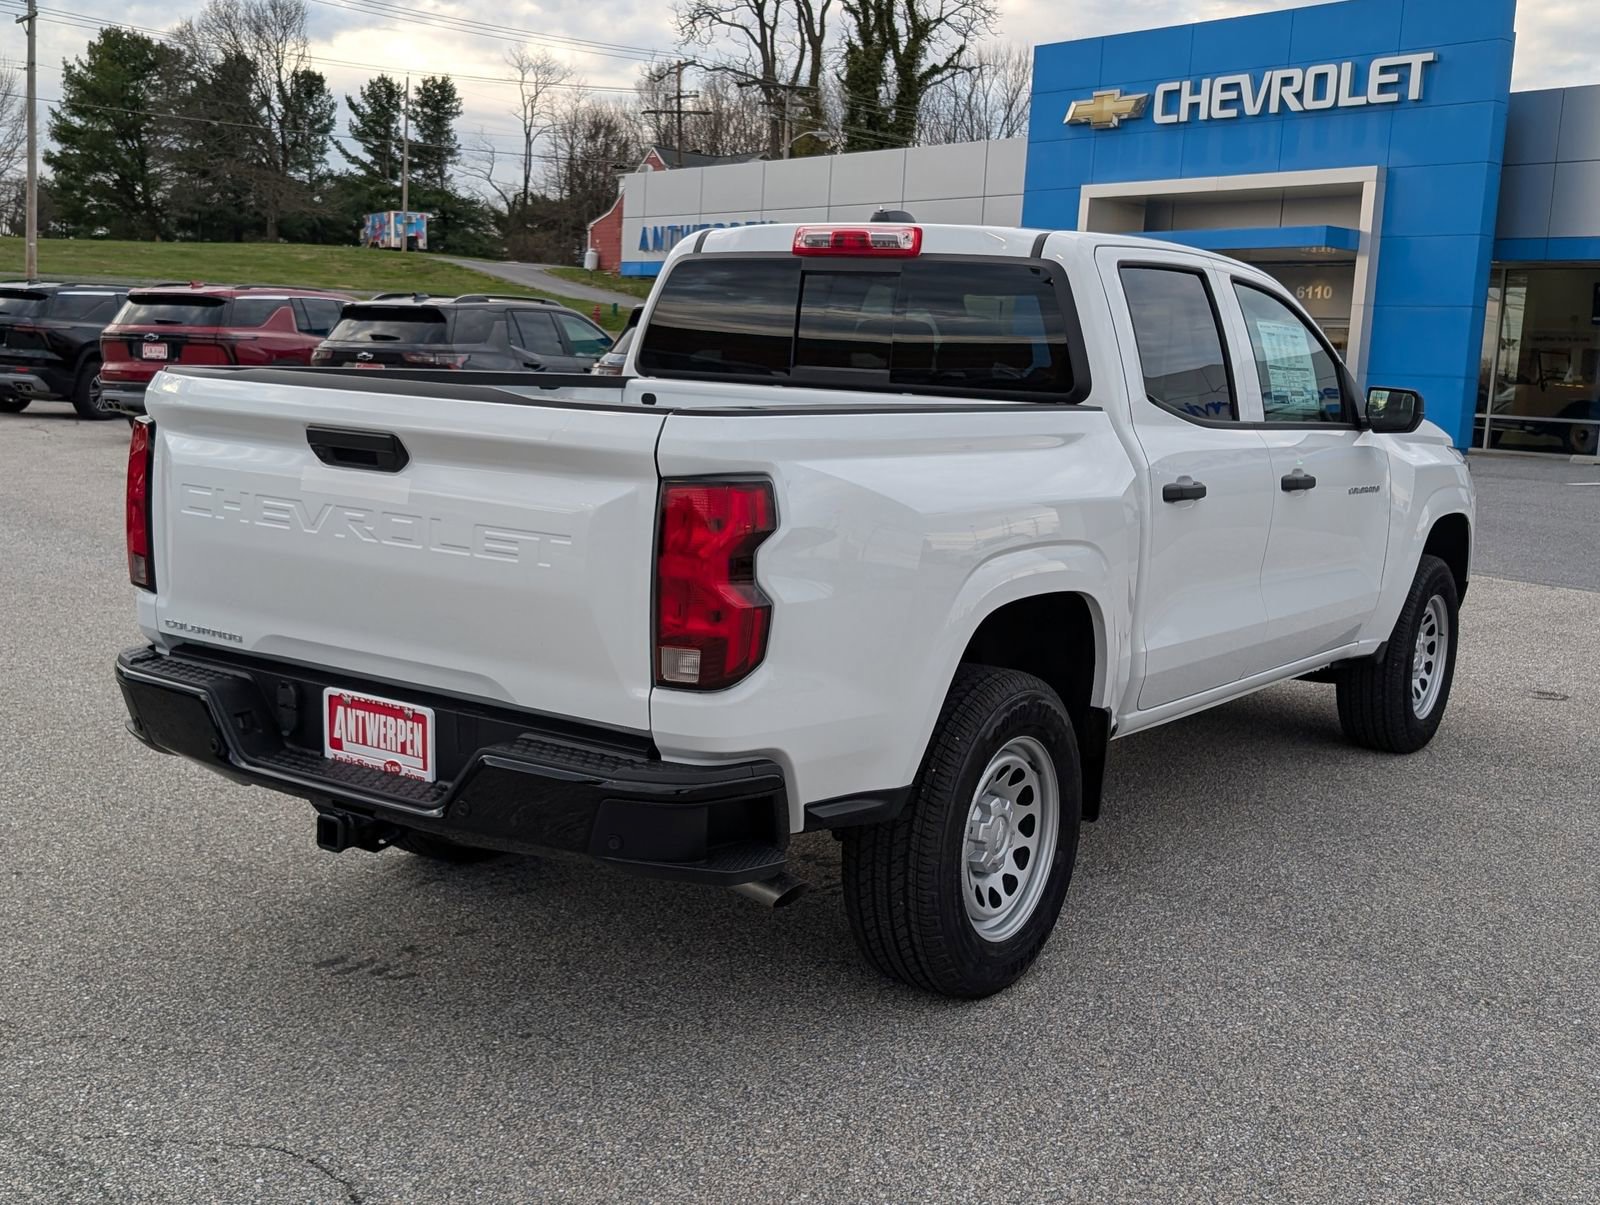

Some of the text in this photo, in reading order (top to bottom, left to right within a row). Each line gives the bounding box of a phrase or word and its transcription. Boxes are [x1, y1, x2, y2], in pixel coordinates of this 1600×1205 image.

[1153, 51, 1436, 124] CHEVROLET
[1296, 285, 1333, 299] 6110
[181, 484, 572, 567] CHEVROLET
[333, 705, 423, 758] ANTWERPEN
